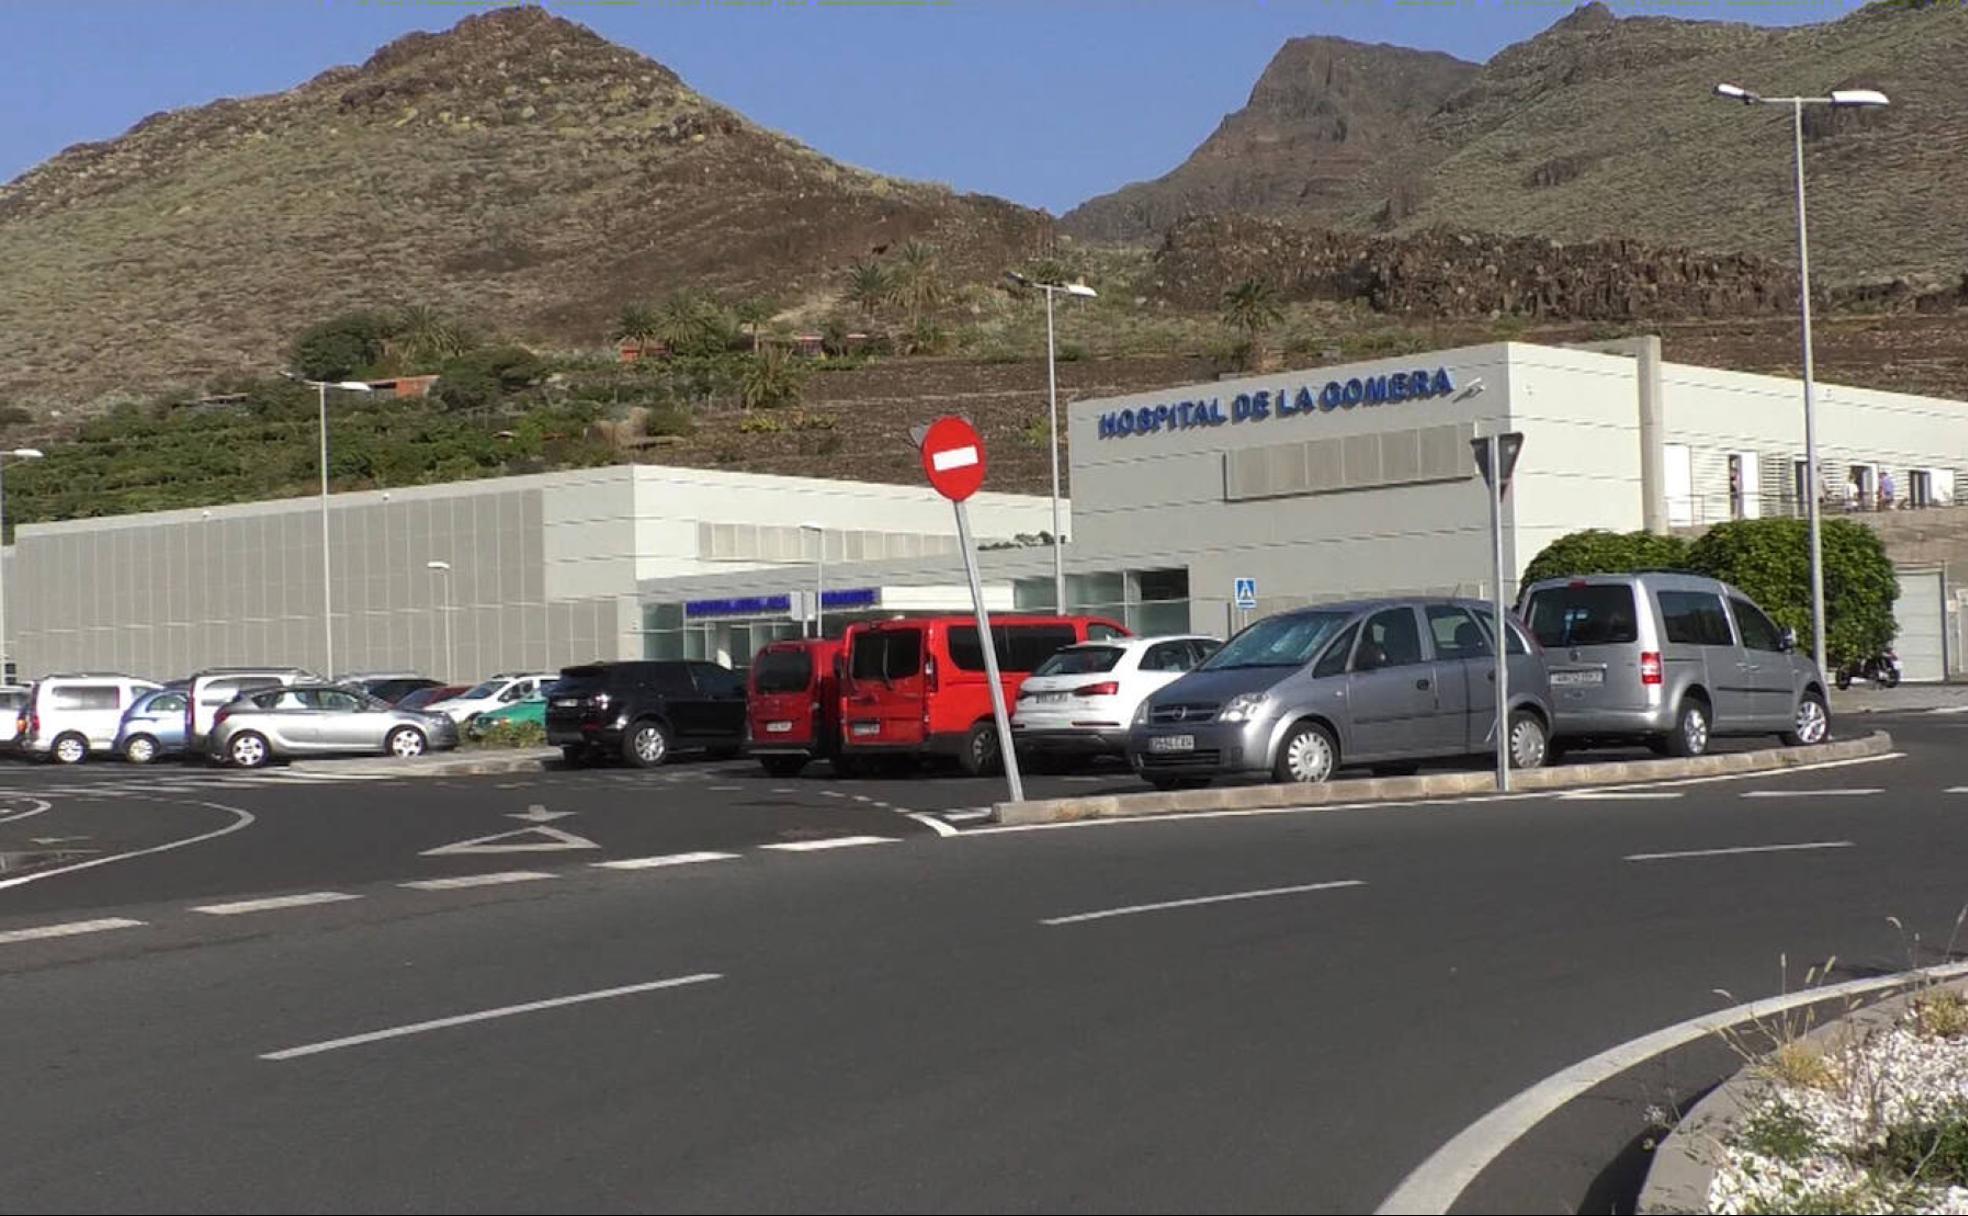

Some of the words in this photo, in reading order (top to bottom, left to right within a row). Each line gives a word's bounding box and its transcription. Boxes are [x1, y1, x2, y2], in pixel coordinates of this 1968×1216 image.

[1098, 398, 1228, 439] HOSPITAL
[1232, 390, 1270, 424] DE
[1277, 388, 1315, 417] LA
[1319, 366, 1454, 412] GOMERA
